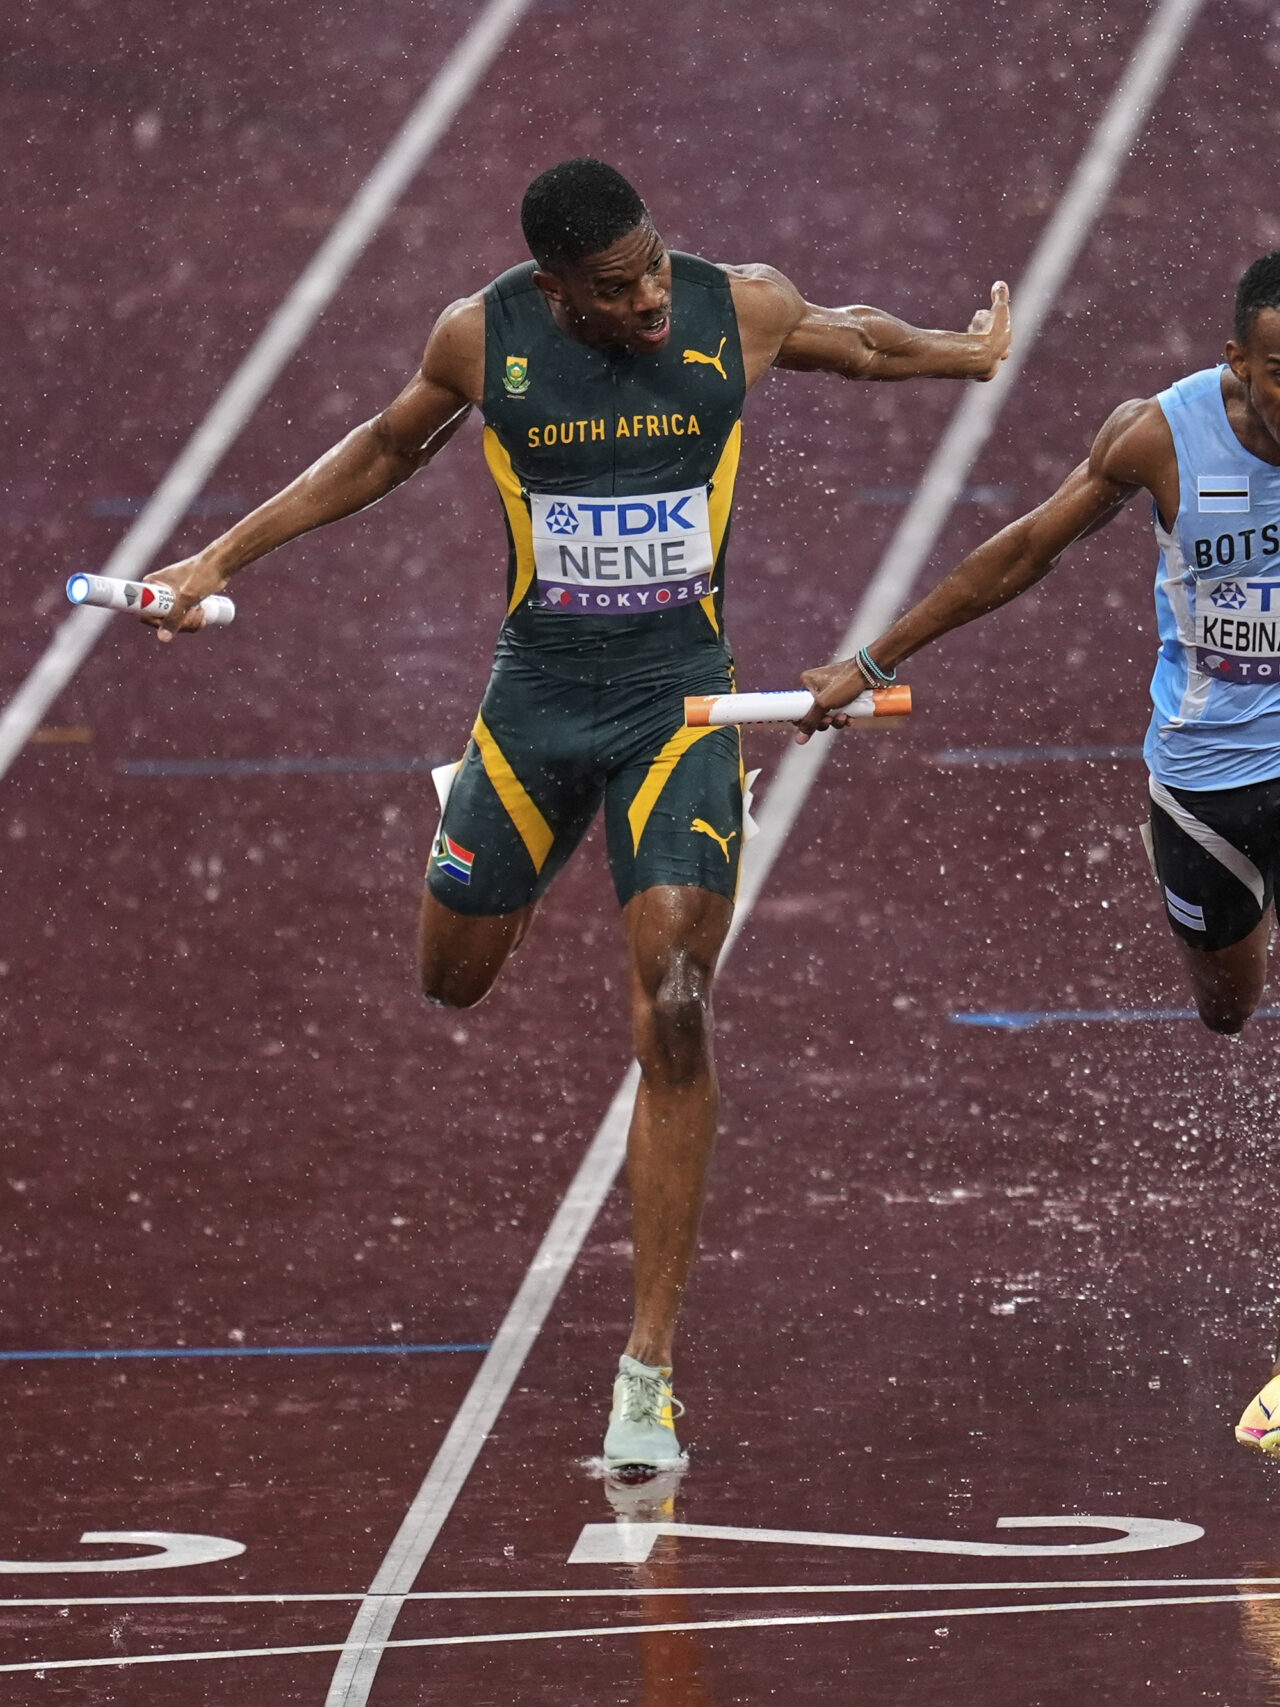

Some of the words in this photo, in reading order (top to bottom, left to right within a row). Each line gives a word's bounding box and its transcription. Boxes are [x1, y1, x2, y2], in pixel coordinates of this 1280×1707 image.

[528, 418, 606, 448] SOUTH
[616, 413, 701, 439] AFRICA
[577, 496, 696, 537] TDK
[558, 539, 688, 581] NENE
